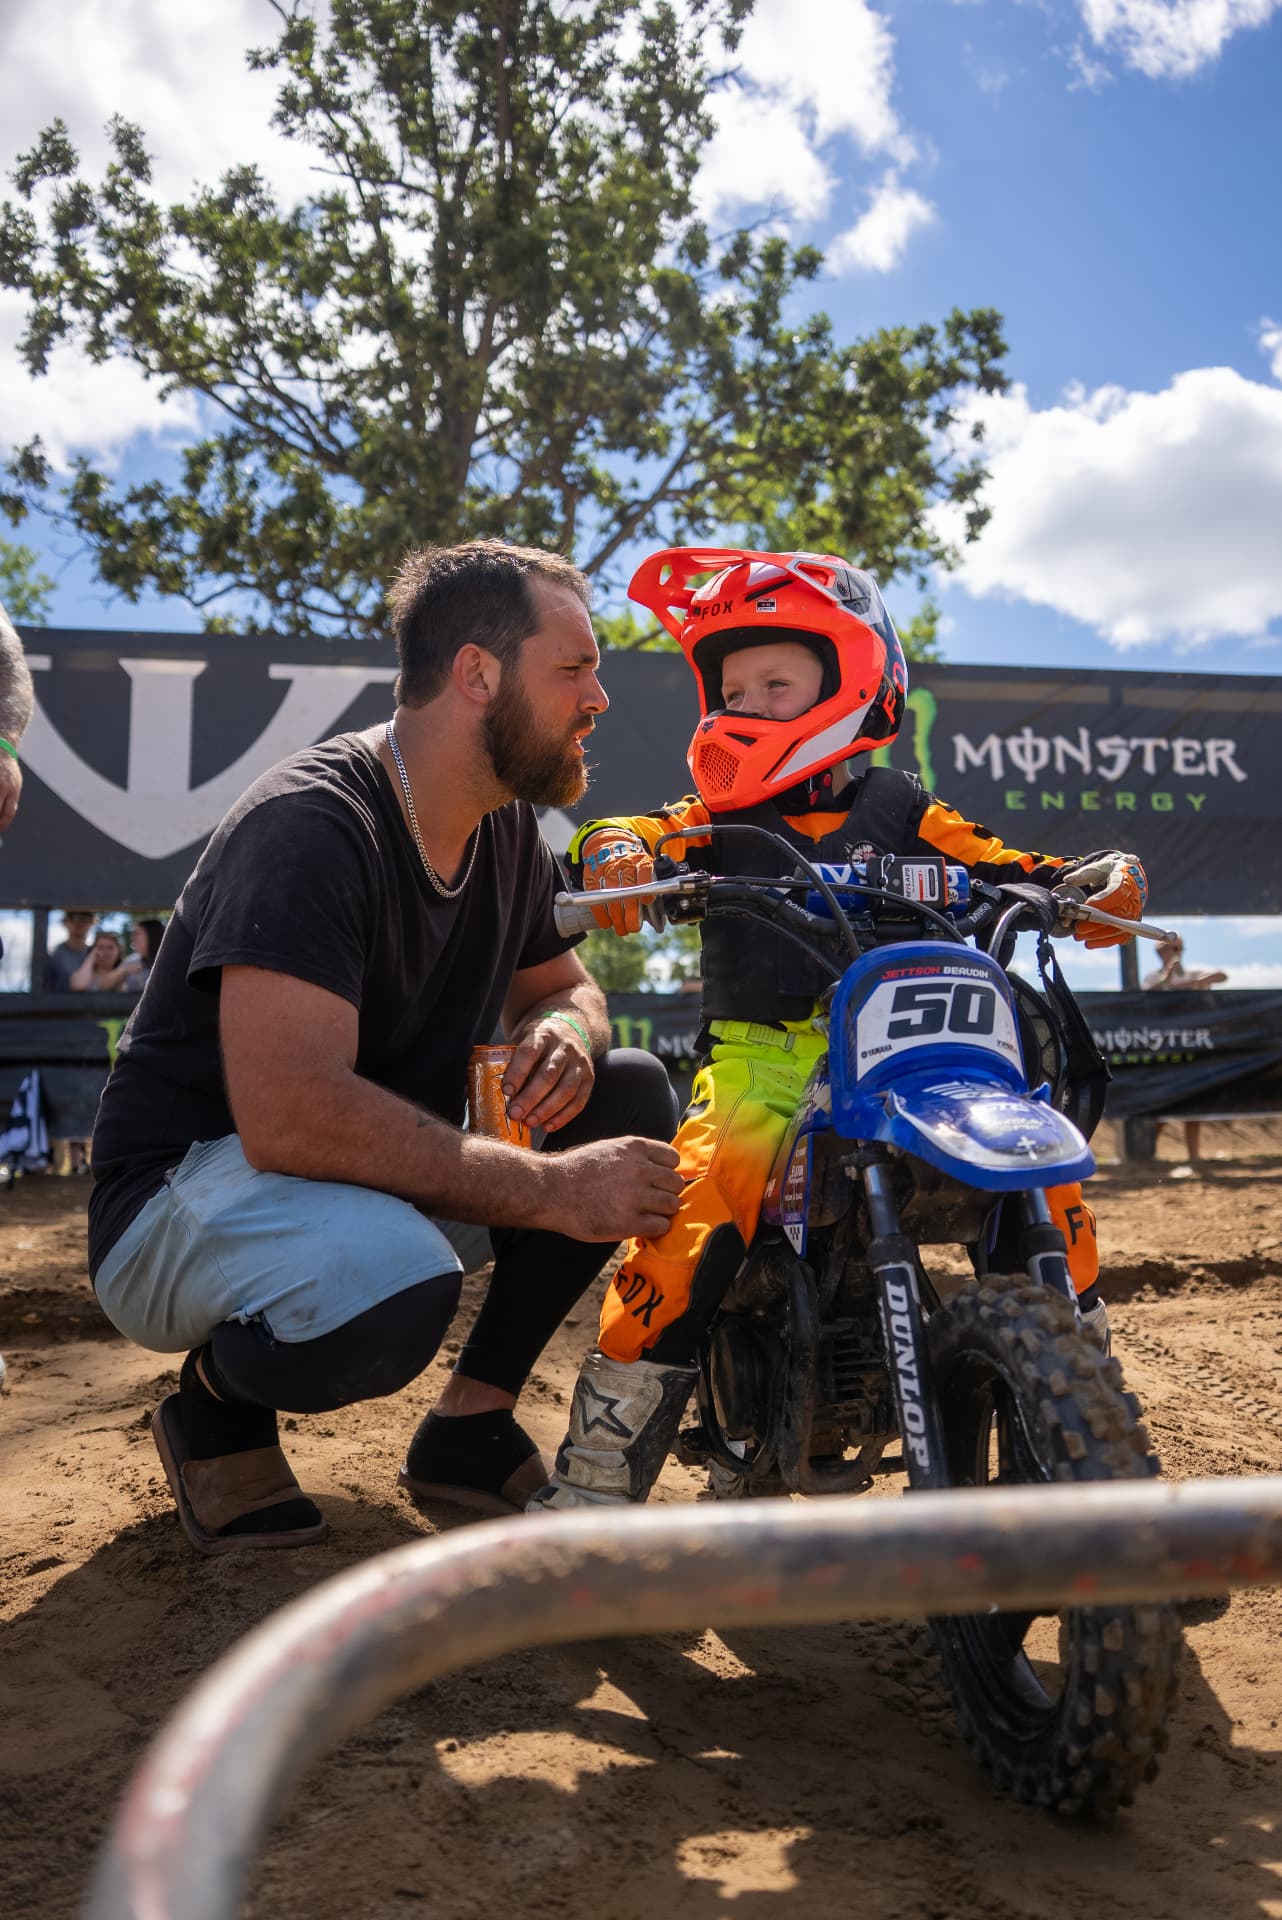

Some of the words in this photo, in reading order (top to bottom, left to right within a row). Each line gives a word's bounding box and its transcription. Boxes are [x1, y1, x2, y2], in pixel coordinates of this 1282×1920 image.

[701, 600, 733, 620] FOX
[953, 726, 1248, 783] MONSTER
[1005, 790, 1208, 812] ENERGY
[882, 966, 941, 980] JETTSON
[943, 965, 989, 979] BEAUDIN
[887, 982, 996, 1040] 50
[1092, 1026, 1215, 1052] MONSTER
[886, 1280, 931, 1468] DUNLOP
